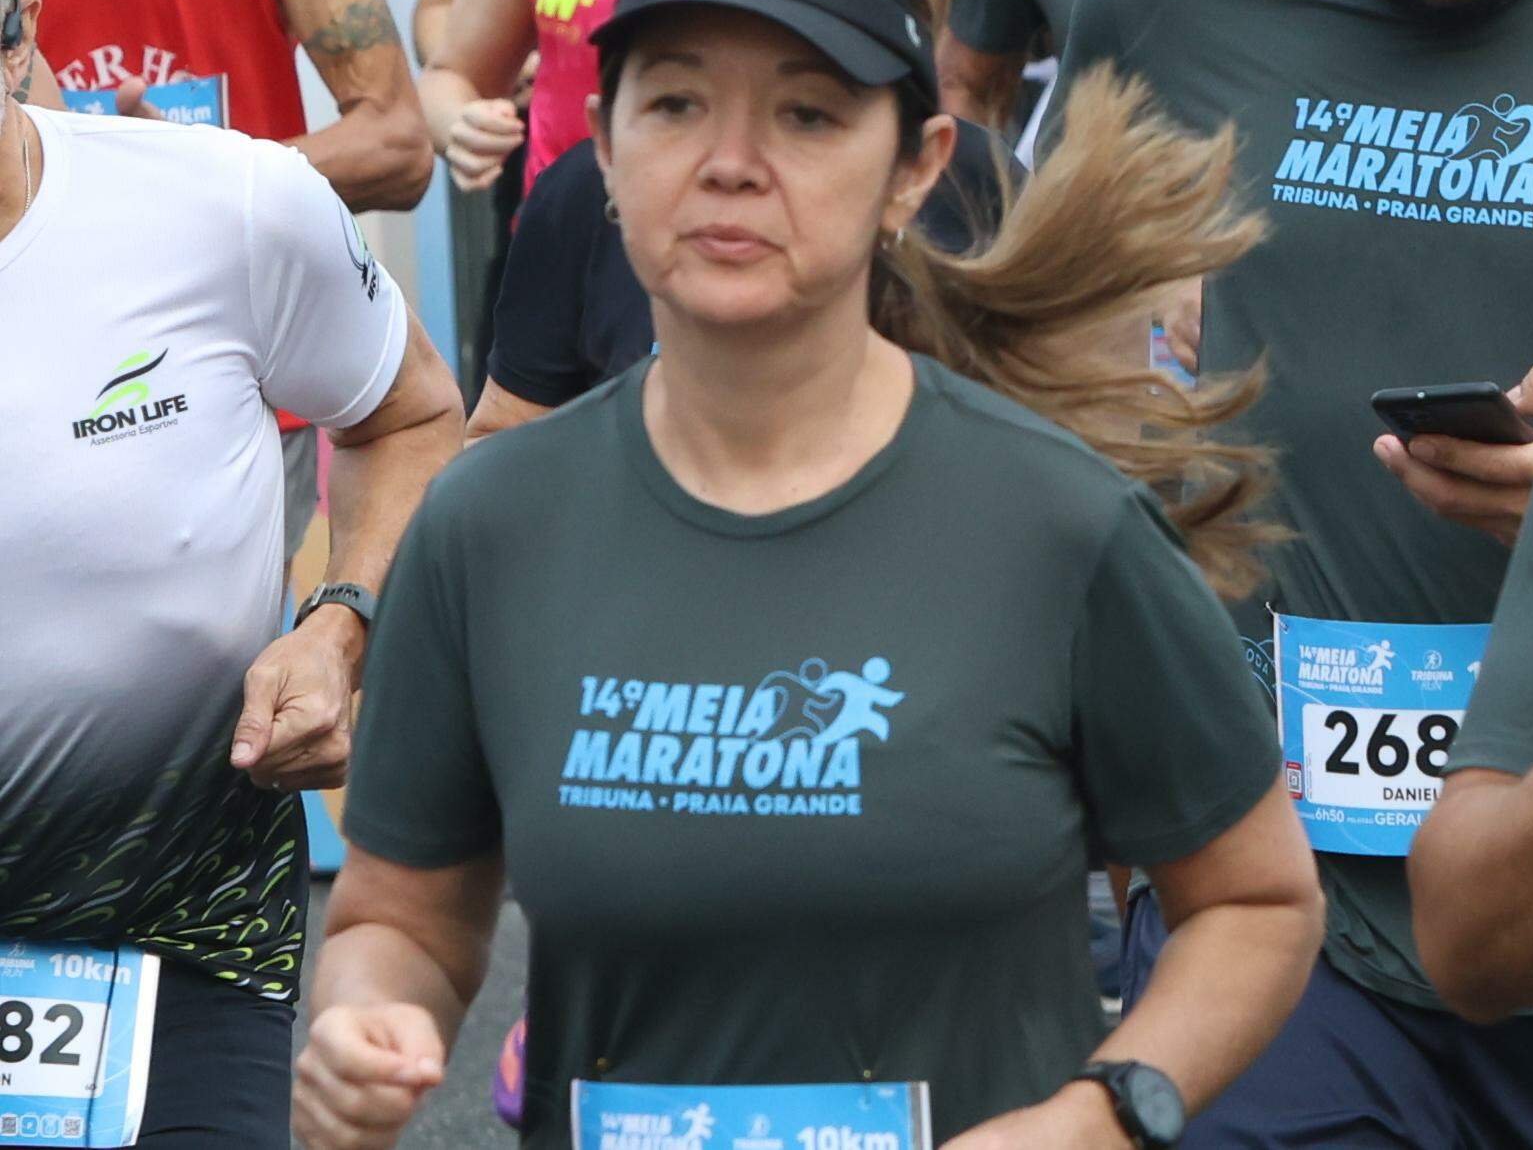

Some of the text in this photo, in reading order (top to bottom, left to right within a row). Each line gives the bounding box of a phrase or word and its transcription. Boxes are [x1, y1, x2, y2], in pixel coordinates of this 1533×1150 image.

[1342, 104, 1471, 154] MEIA
[1272, 183, 1359, 212] TRIBUNA
[1376, 199, 1442, 222] PRAIA
[72, 393, 189, 440] IRON LIFE
[1299, 662, 1384, 686] MARATONA
[1314, 648, 1357, 666] MEIA
[632, 681, 780, 736] MEIA
[561, 729, 862, 789] MARATONA
[558, 784, 863, 816] TRIBUNA PRAIA GRANDE
[48, 952, 132, 985] 10km
[796, 1125, 900, 1150] 10km
